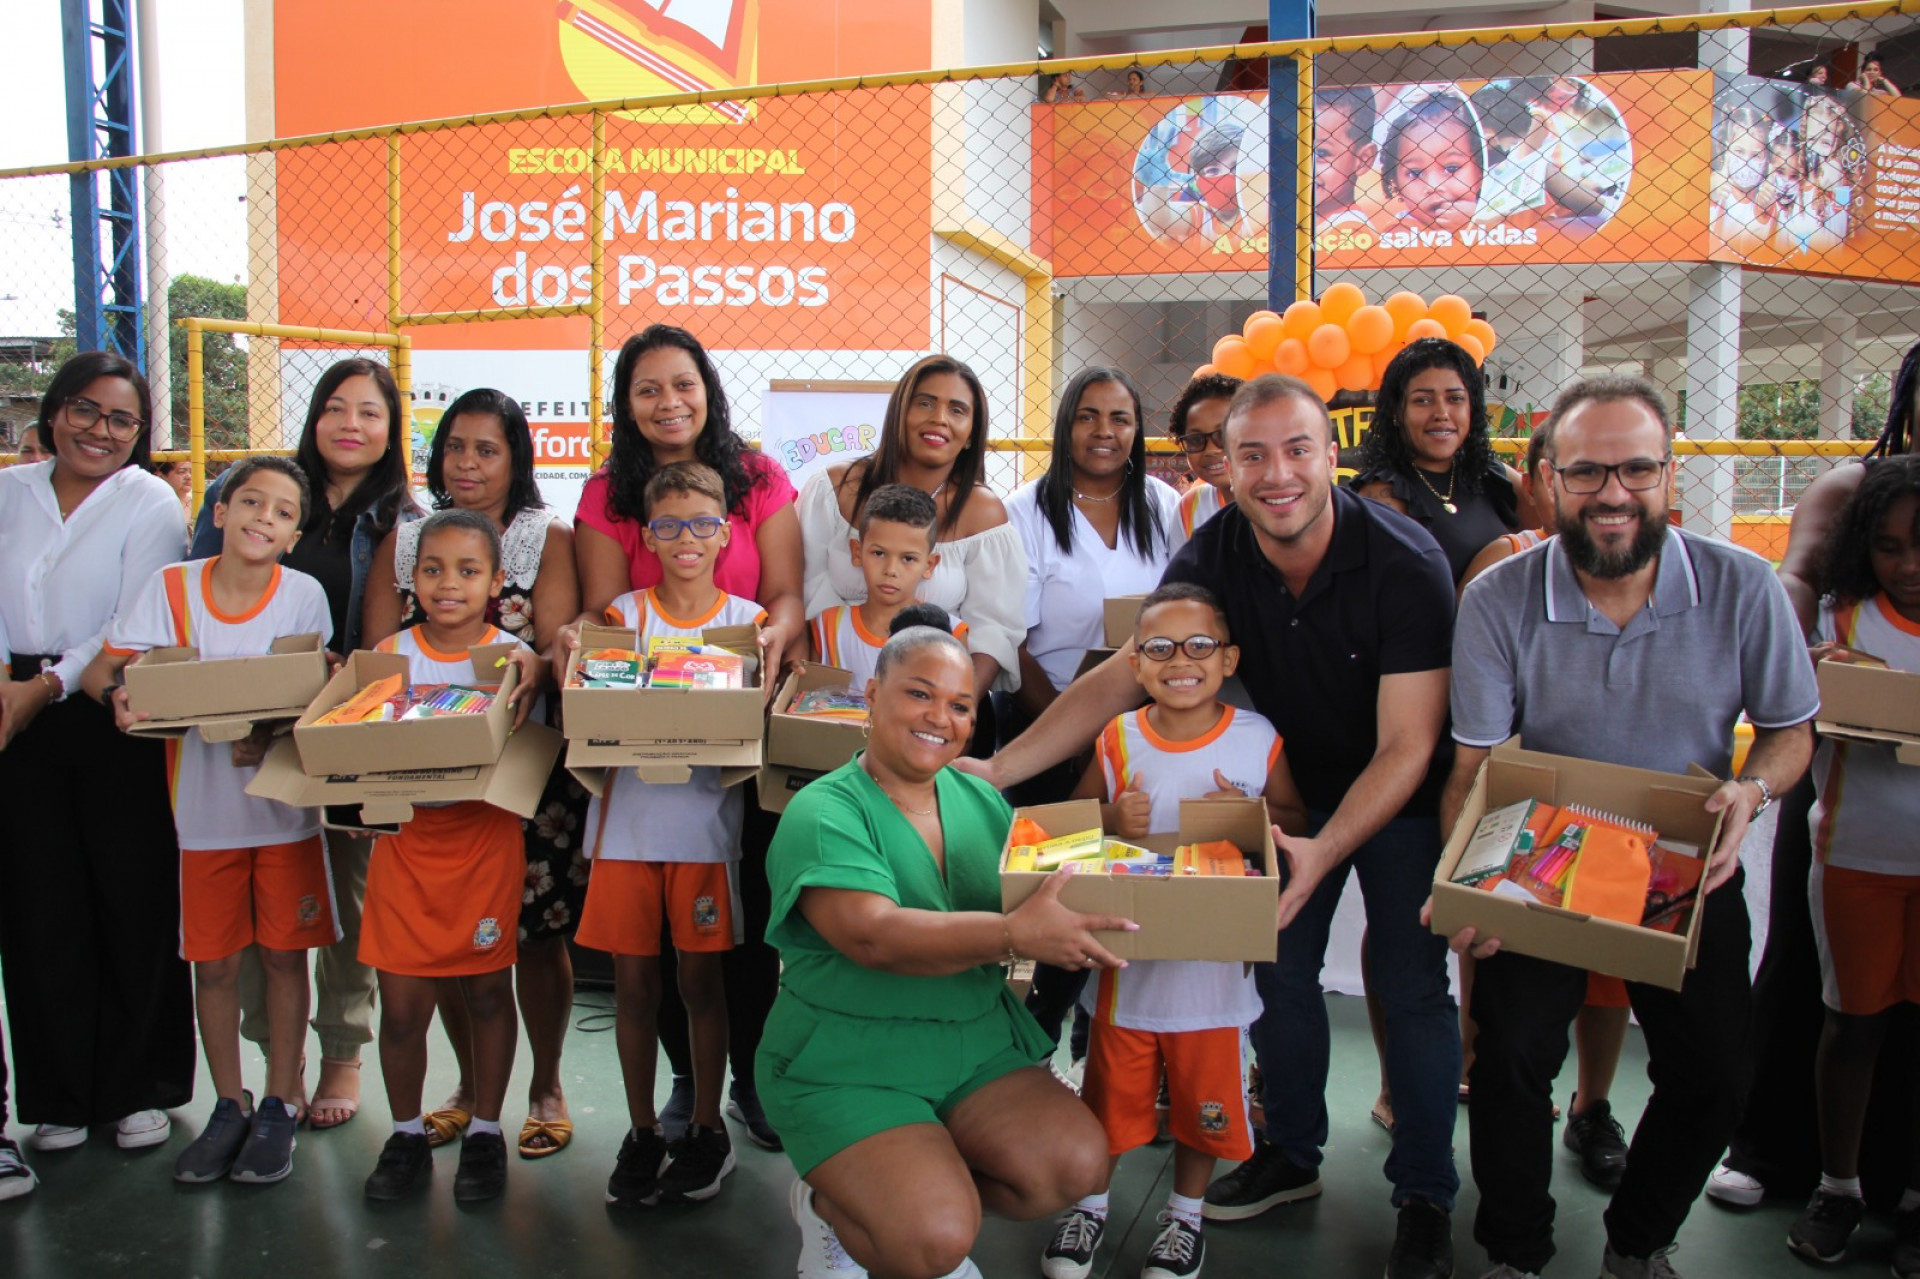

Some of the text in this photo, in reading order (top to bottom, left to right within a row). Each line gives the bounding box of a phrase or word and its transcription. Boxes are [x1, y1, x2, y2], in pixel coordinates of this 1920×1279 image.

[630, 148, 806, 175] MUNICIPAL
[1900, 187, 1920, 198] pod
[448, 184, 856, 242] José Mariano
[1212, 234, 1234, 254] A
[1379, 226, 1453, 249] salva
[1459, 224, 1538, 247] vidas
[492, 252, 829, 307] dos Passos
[781, 424, 876, 470] EDUCAR
